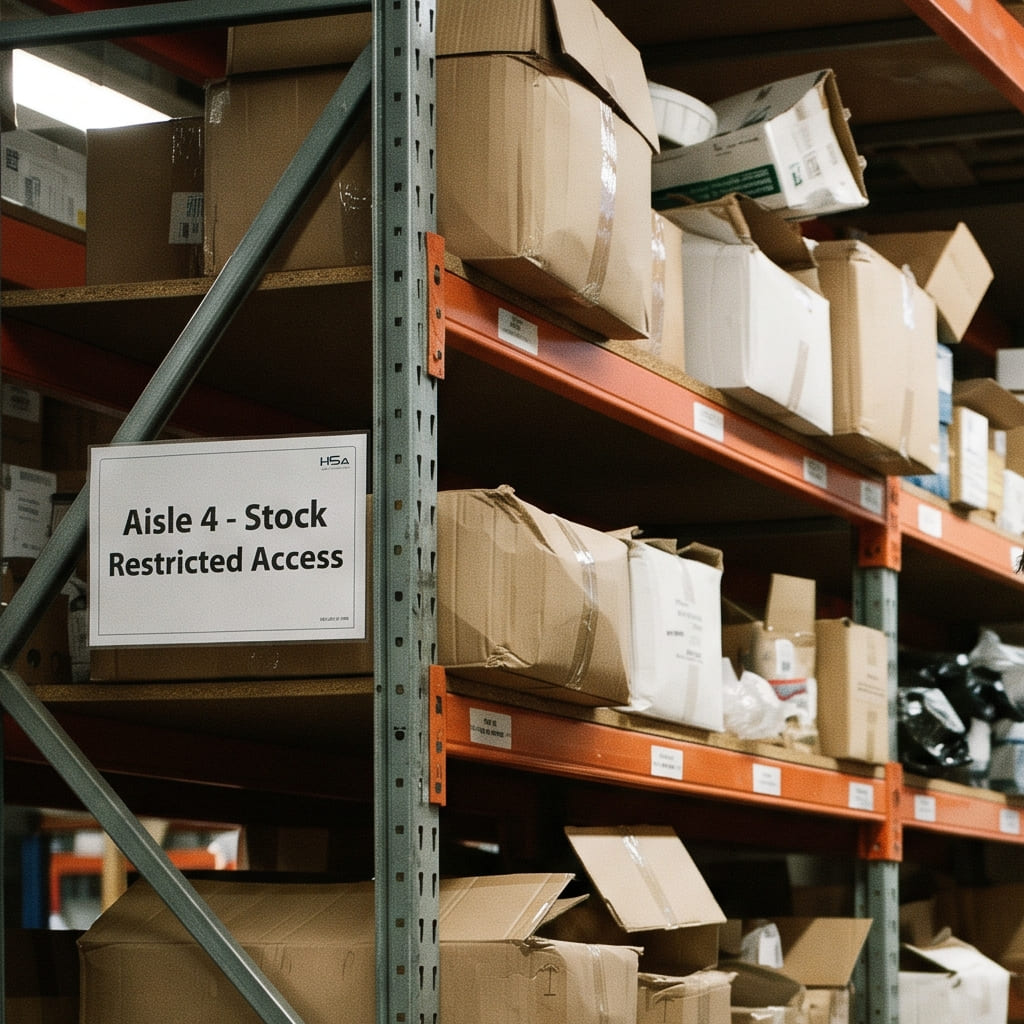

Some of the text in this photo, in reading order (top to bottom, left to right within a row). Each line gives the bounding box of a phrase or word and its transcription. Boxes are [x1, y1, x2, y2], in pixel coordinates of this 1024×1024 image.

[122, 505, 193, 536] Aisle
[200, 506, 218, 532] 4
[244, 499, 328, 531] Stock
[108, 546, 344, 577] Restricted Access
